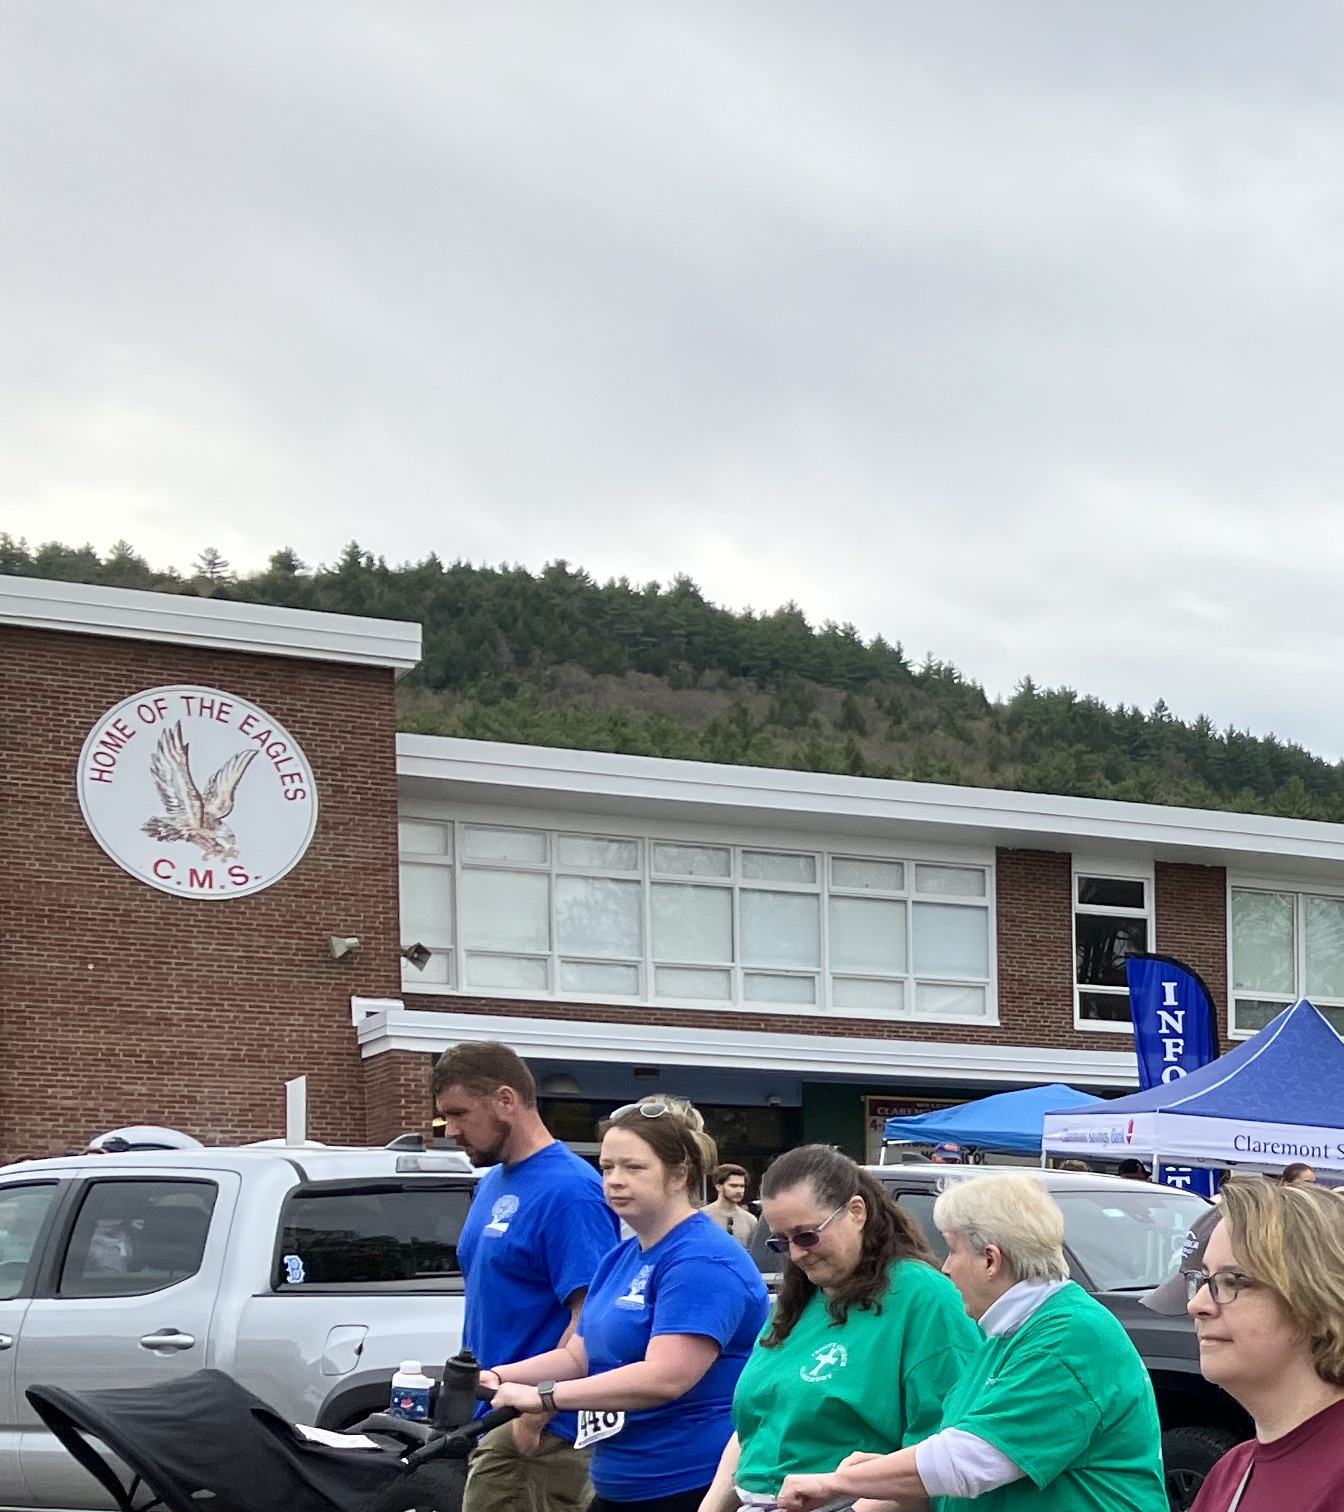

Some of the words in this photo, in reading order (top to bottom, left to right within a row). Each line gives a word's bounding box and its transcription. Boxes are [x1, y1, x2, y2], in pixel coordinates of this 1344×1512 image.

[89, 718, 137, 783] HOME
[137, 697, 168, 724] OF
[181, 695, 233, 723] THE
[237, 713, 306, 801] EAGLES
[152, 858, 262, 889] C.M.S.
[1233, 1134, 1330, 1159] Claremont
